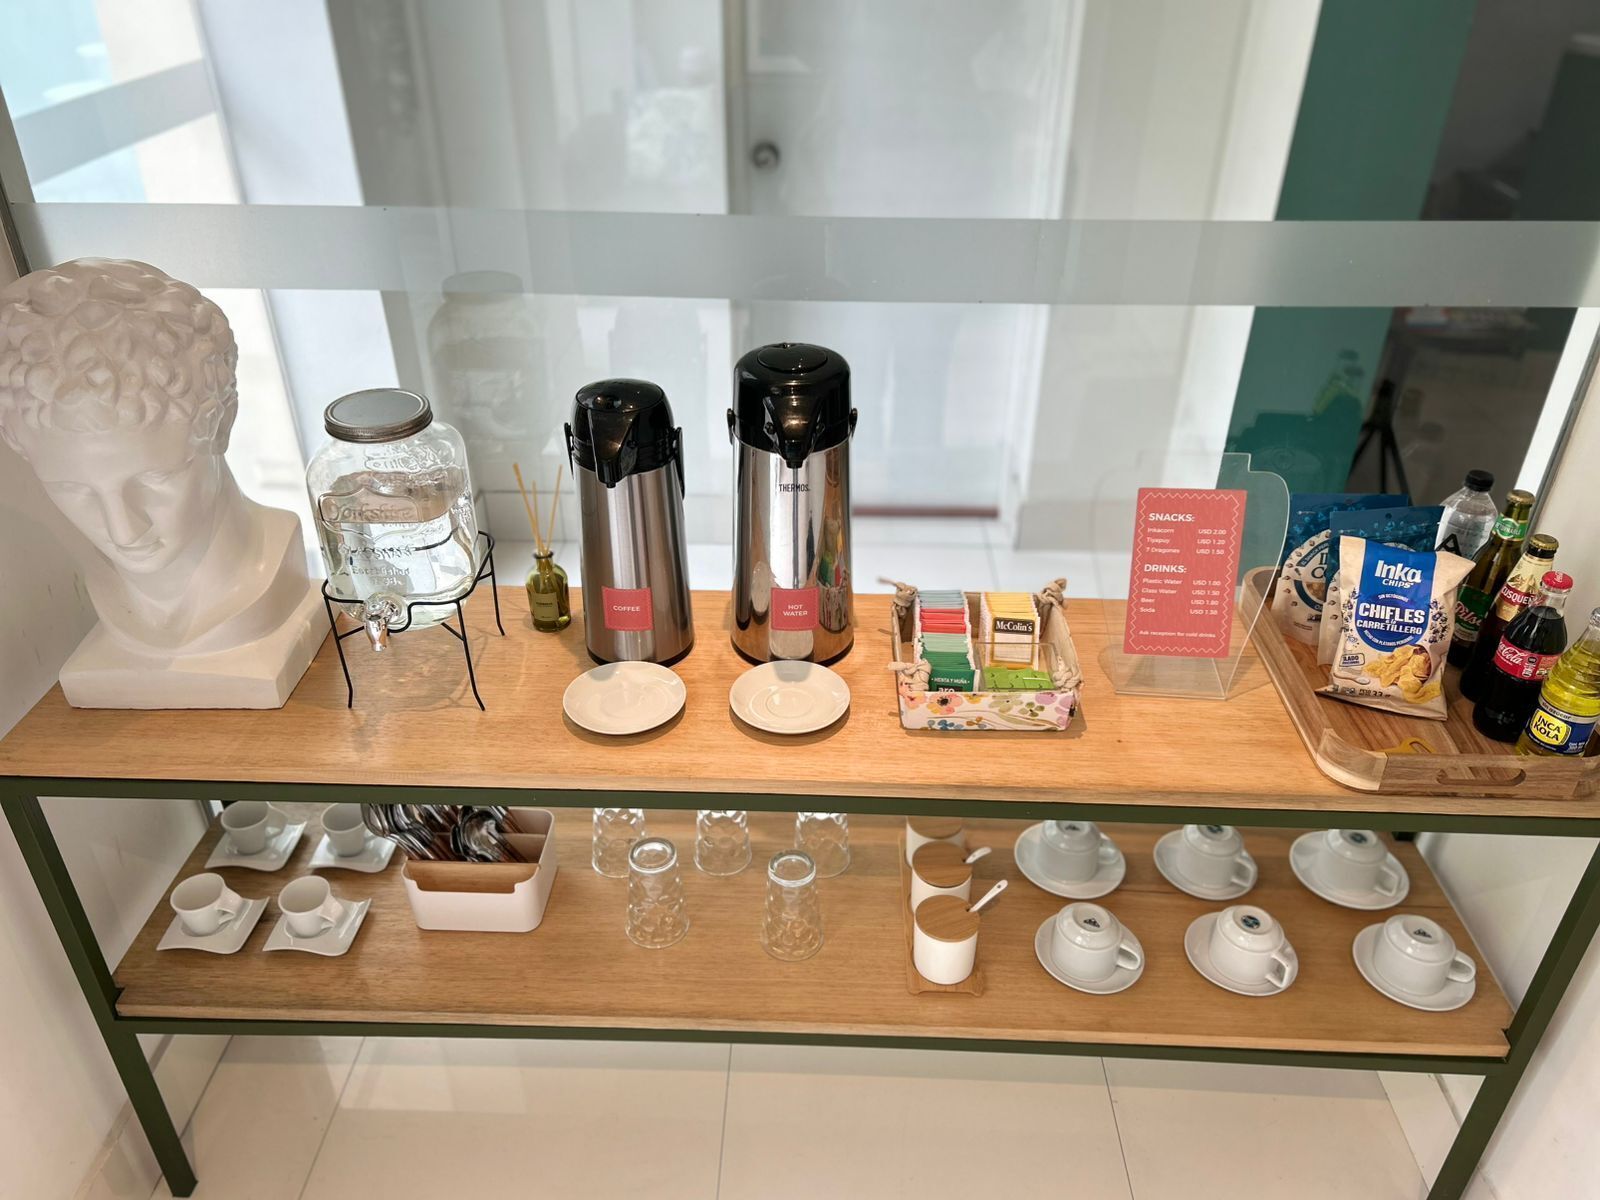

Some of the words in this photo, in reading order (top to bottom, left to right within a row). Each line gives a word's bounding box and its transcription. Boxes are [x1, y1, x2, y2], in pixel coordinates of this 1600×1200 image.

[1148, 512, 1195, 522] SNACKS:
[1143, 563, 1188, 573] DRINKS:
[1374, 559, 1422, 584] Inka
[1382, 578, 1412, 589] CHIPS
[612, 604, 641, 612] COFFEE
[787, 603, 803, 611] HOT
[1358, 602, 1426, 624] CHIFLES
[995, 620, 1033, 633] McColin's
[1356, 619, 1423, 635] CARRETILLERO
[1537, 715, 1562, 734] INCA
[1533, 721, 1560, 742] KOLA
